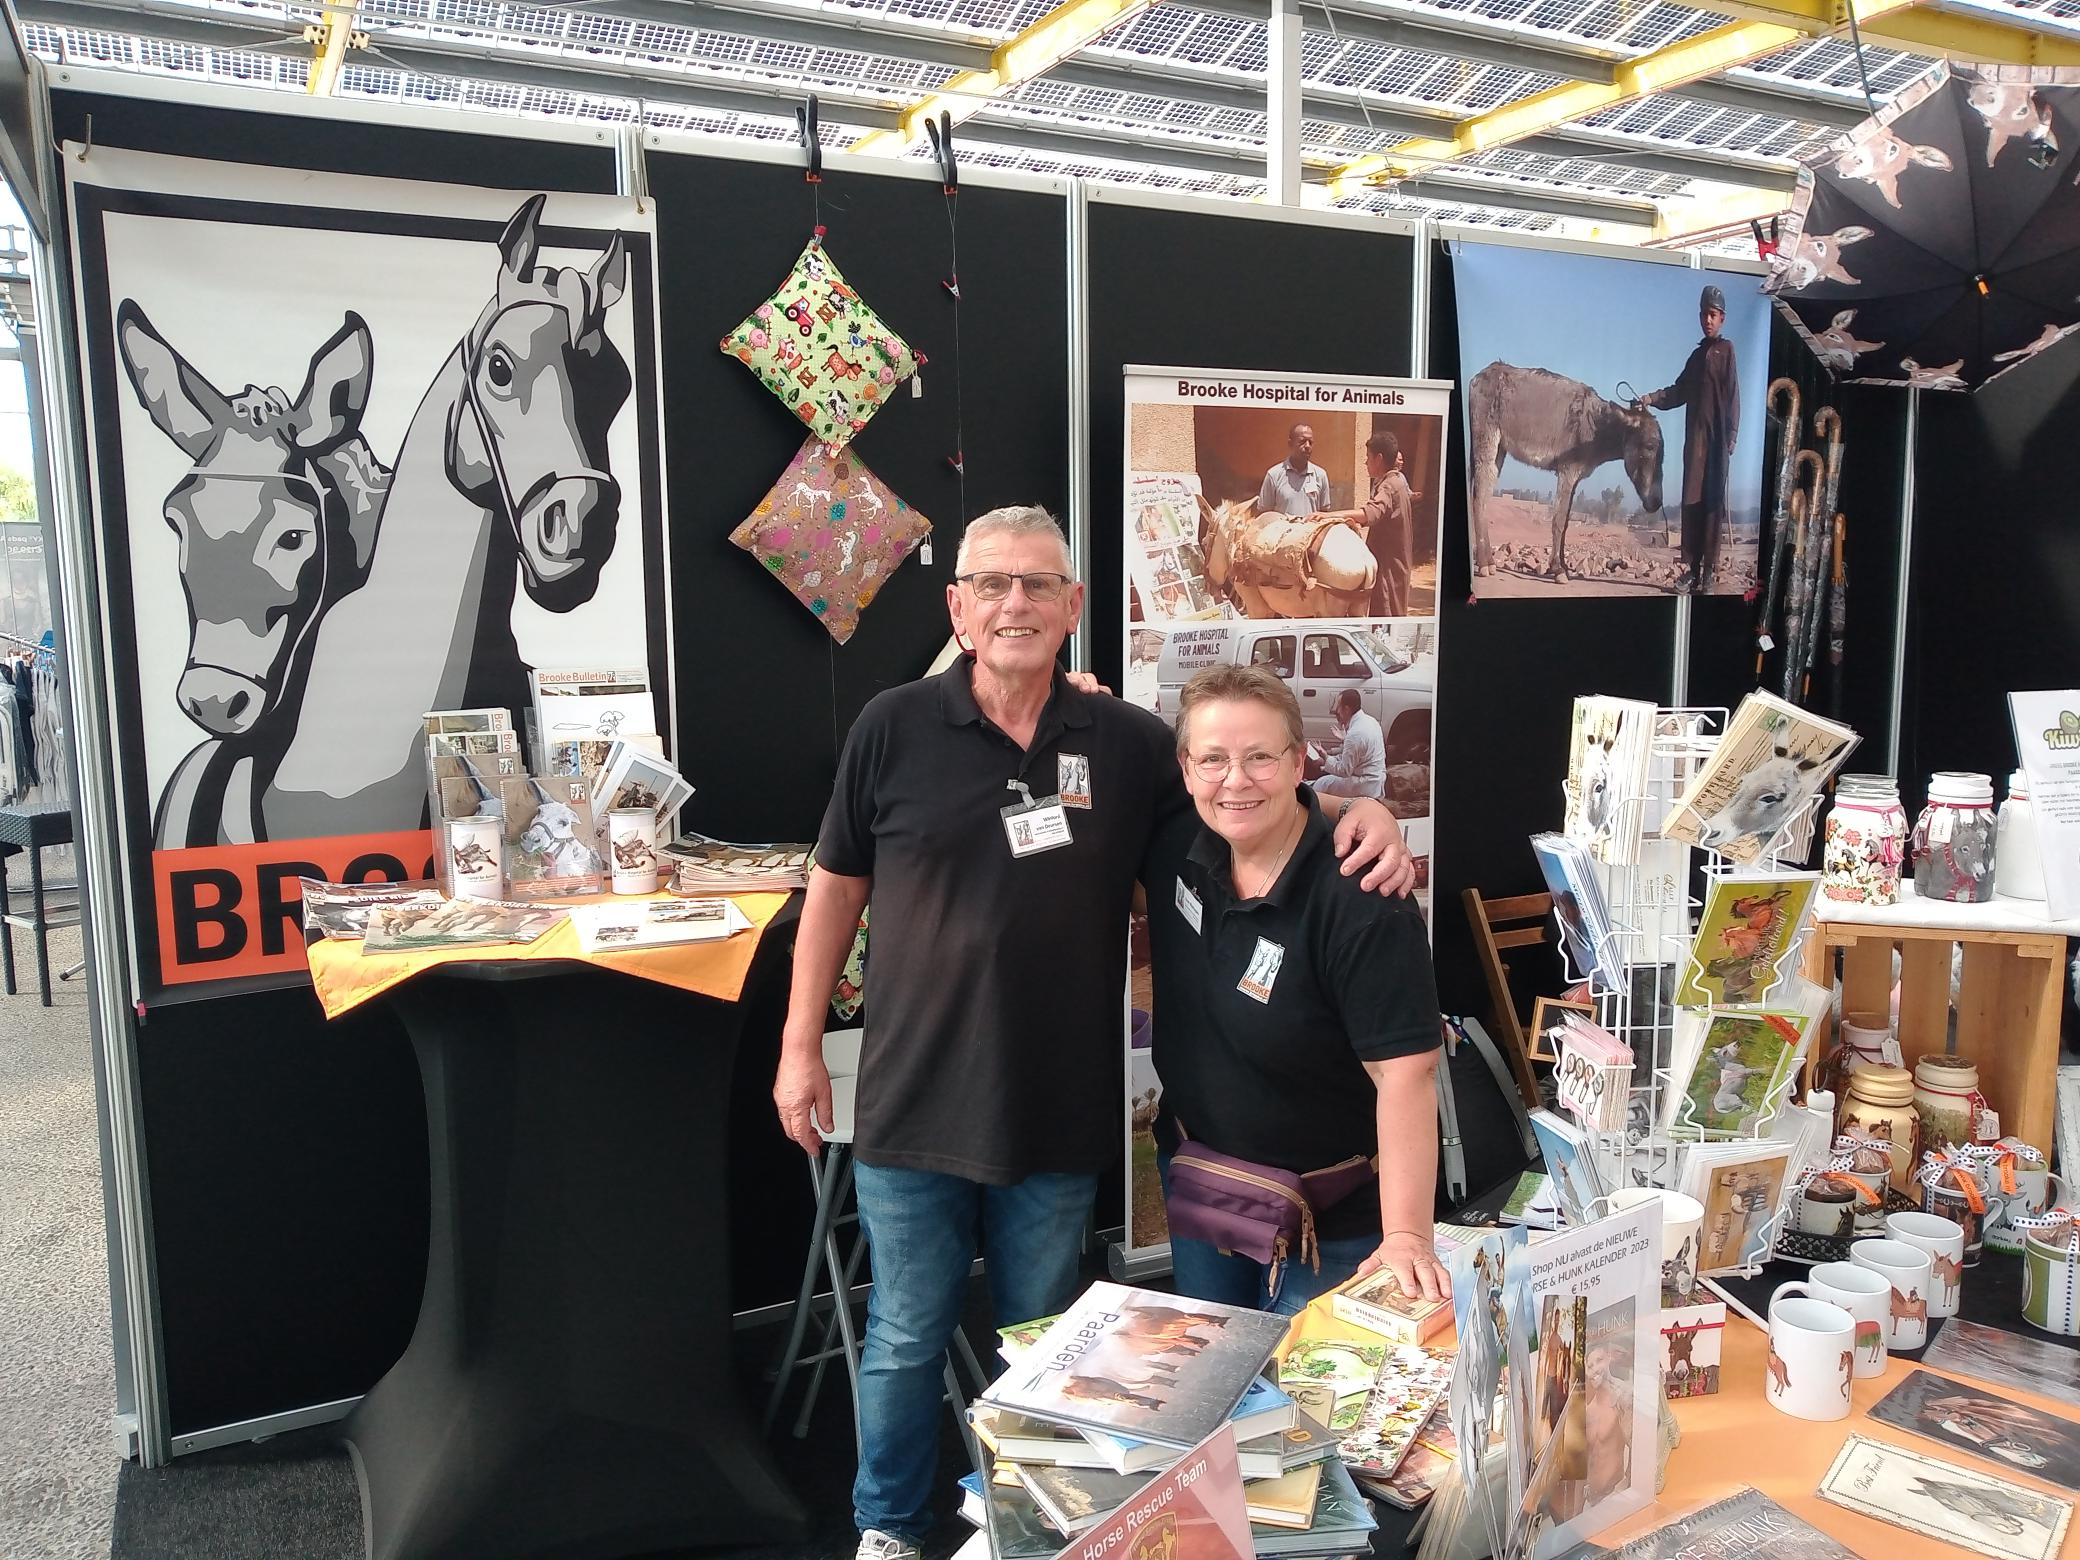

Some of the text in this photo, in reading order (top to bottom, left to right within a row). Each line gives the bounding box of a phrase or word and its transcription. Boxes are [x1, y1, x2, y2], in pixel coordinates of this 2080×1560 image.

[1178, 380, 1405, 405] Brooke Hospital for Animals
[1173, 628, 1229, 644] BROOKE HOSPITAL
[1178, 643, 1220, 657] FOR ANIMALS
[1178, 661, 1199, 669] MOBILE
[538, 672, 572, 682] Brooke
[572, 671, 607, 681] Bulletin
[1061, 794, 1089, 804] BROOKE
[1243, 979, 1270, 998] BROOKE
[1532, 1227, 1638, 1276] Shop NU alvast de NIEUWE
[1550, 1275, 1556, 1286] &
[1558, 1264, 1583, 1283] HUNK
[1584, 1246, 1627, 1274] KALENDER
[1631, 1238, 1649, 1254] 2023
[1571, 1284, 1577, 1294] €
[1597, 1311, 1629, 1336] HUNK
[1046, 1311, 1121, 1372] Paarden
[1083, 1525, 1125, 1560] Horse
[1126, 1487, 1174, 1533] Rescue
[1174, 1458, 1208, 1492] Team
[1714, 1511, 1788, 1552] HUNK
